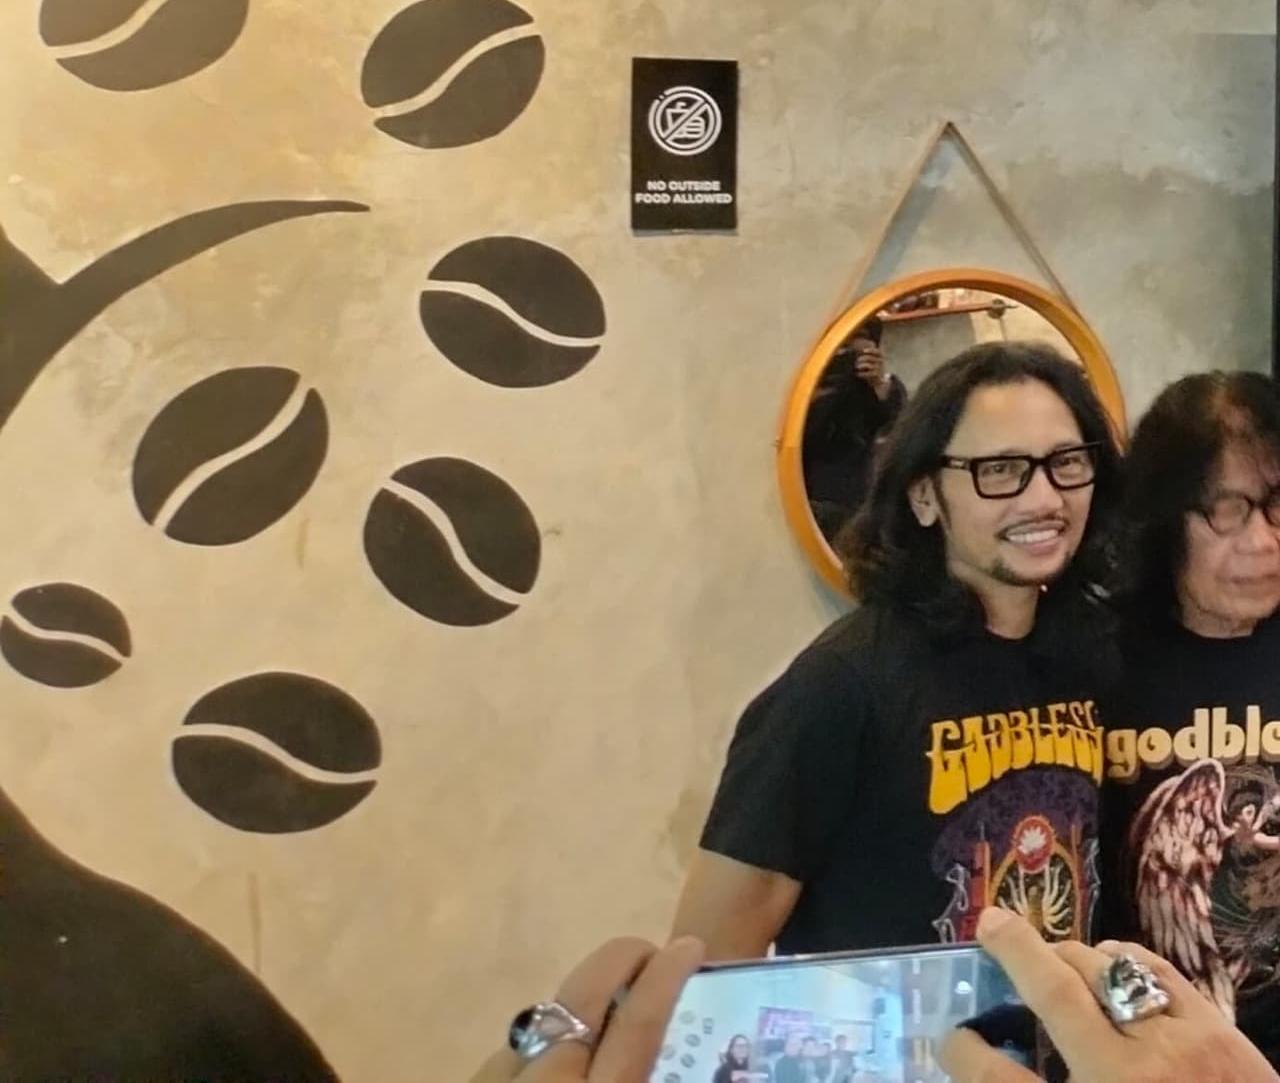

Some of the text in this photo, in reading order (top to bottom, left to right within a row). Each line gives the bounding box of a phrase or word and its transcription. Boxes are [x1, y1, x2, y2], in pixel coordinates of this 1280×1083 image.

[647, 180, 720, 191] NO OUTSIDE
[635, 193, 733, 204] FOOD ALLOWED
